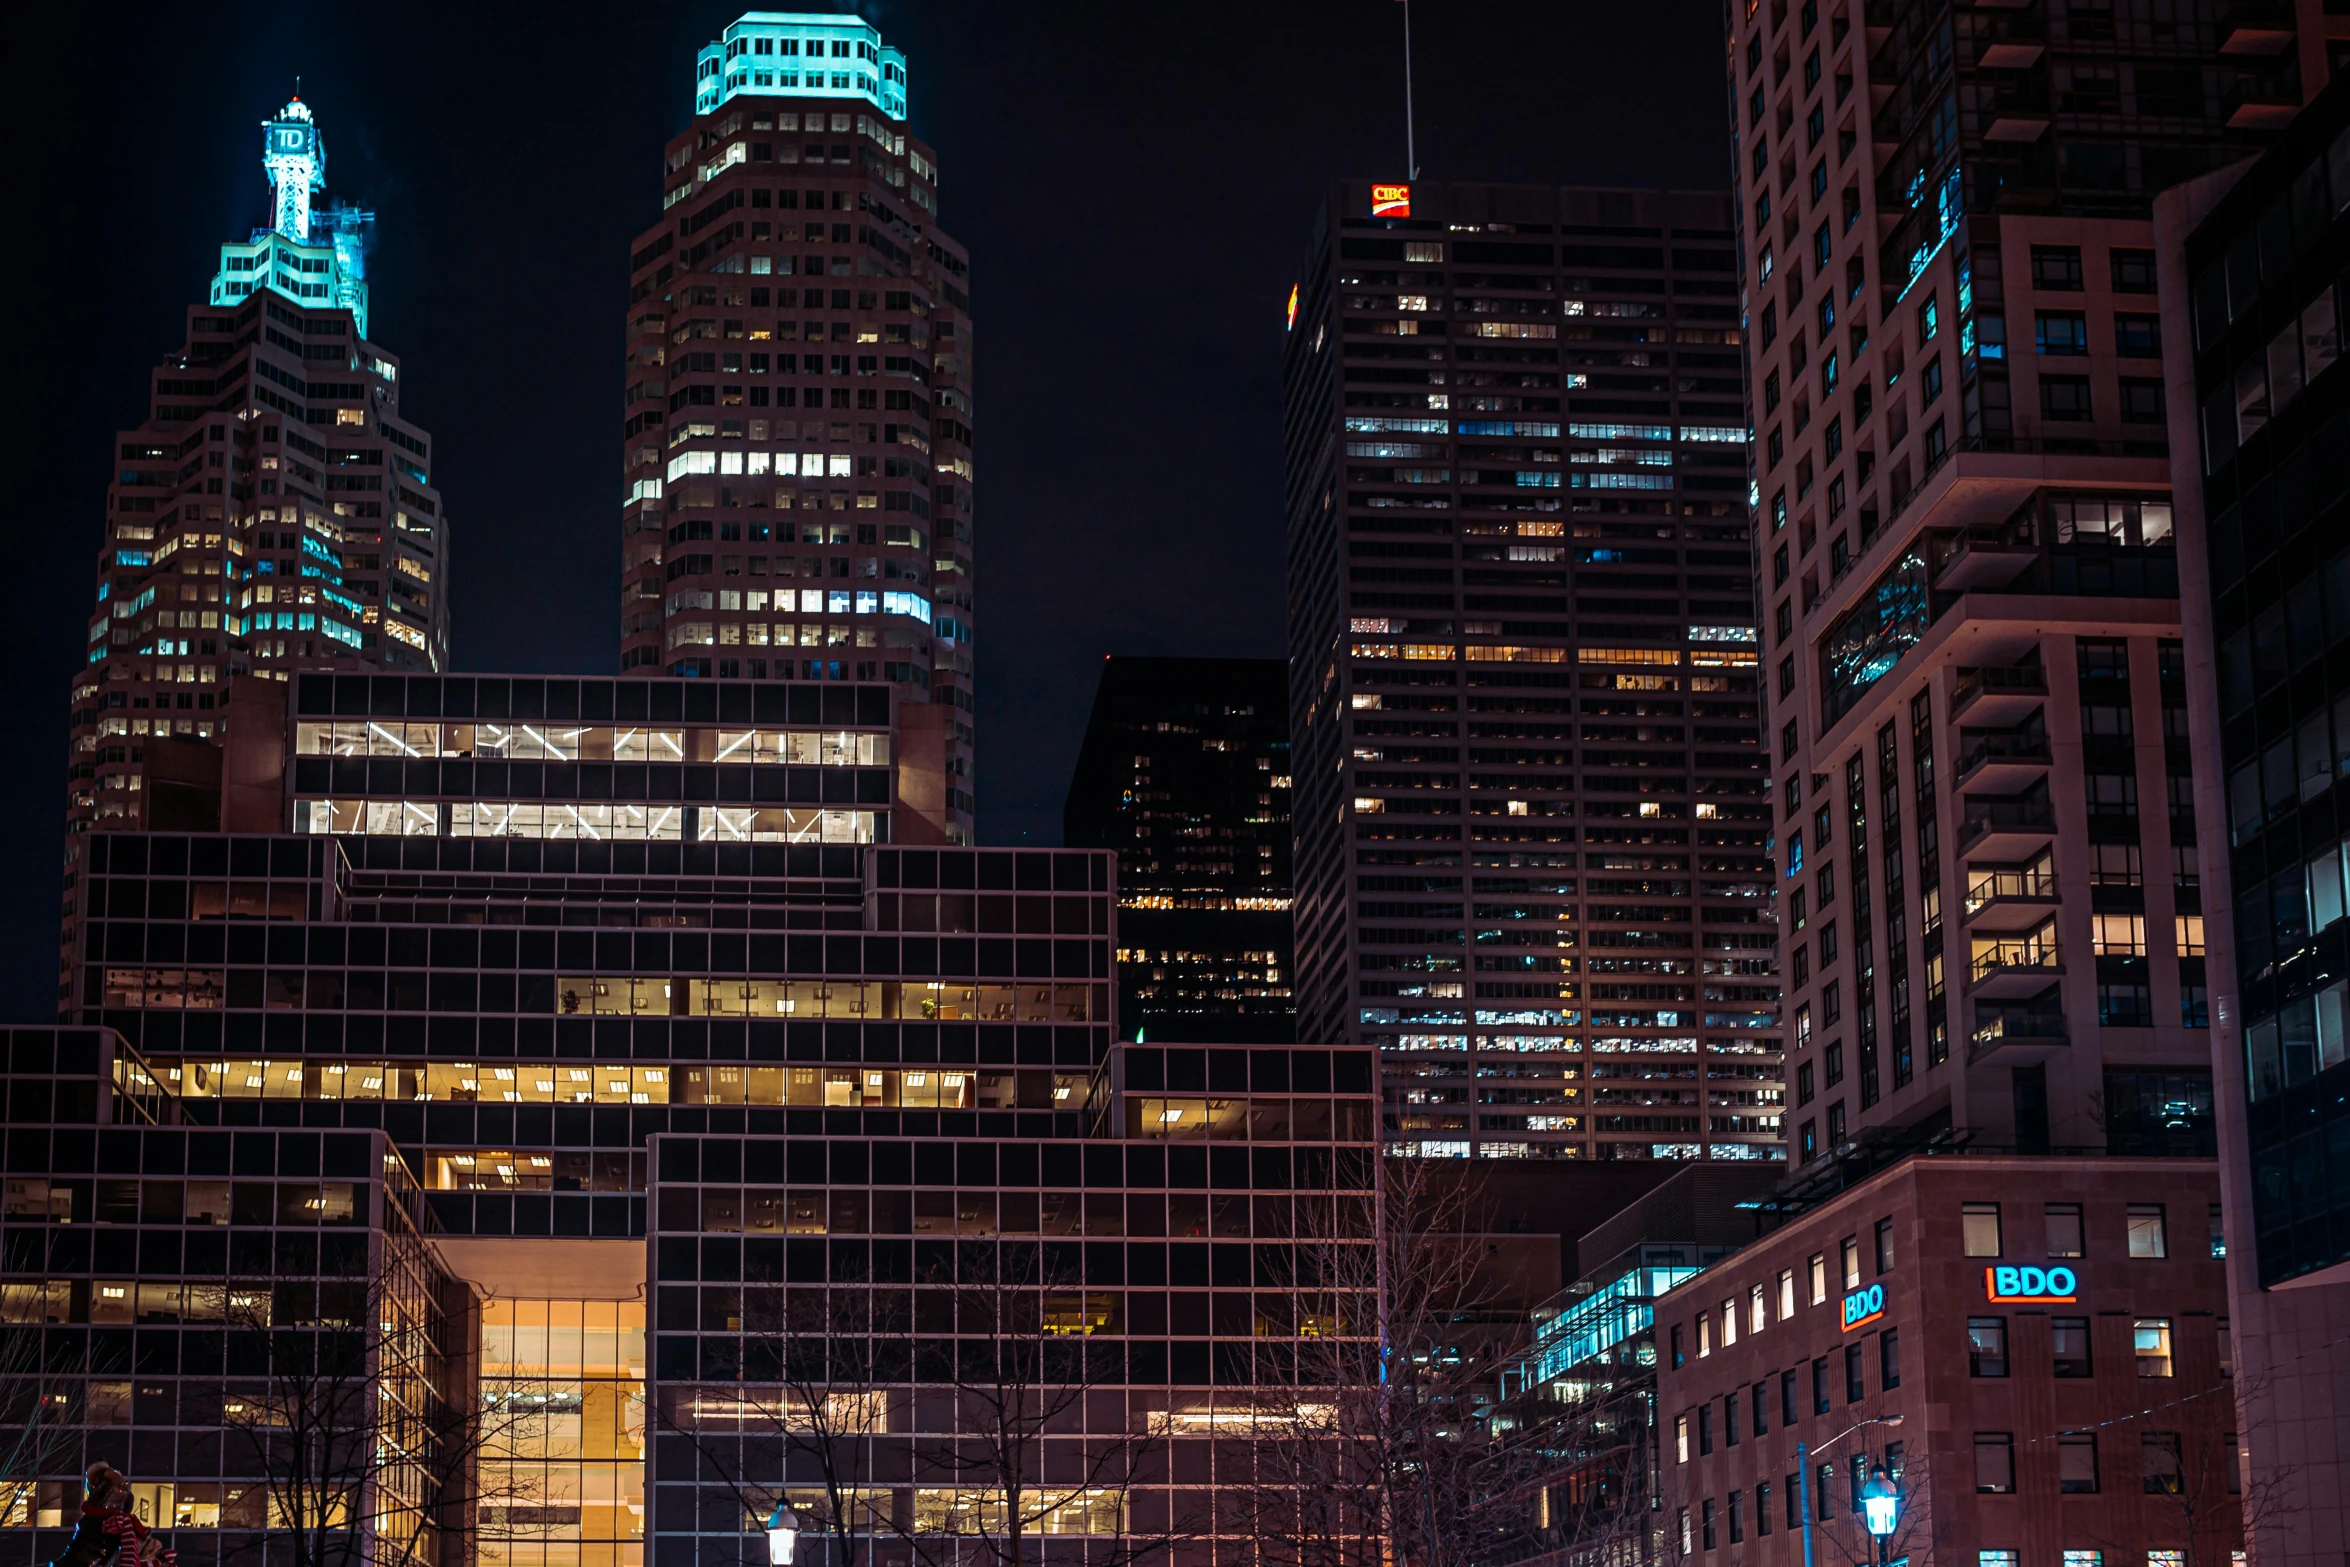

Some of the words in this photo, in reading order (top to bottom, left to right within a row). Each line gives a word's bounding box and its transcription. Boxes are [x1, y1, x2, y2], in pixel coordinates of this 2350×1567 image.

[275, 129, 303, 148] TD
[1373, 187, 1408, 201] CIBC
[1996, 1267, 2076, 1296] BDO
[1845, 1284, 1883, 1324] BDO
